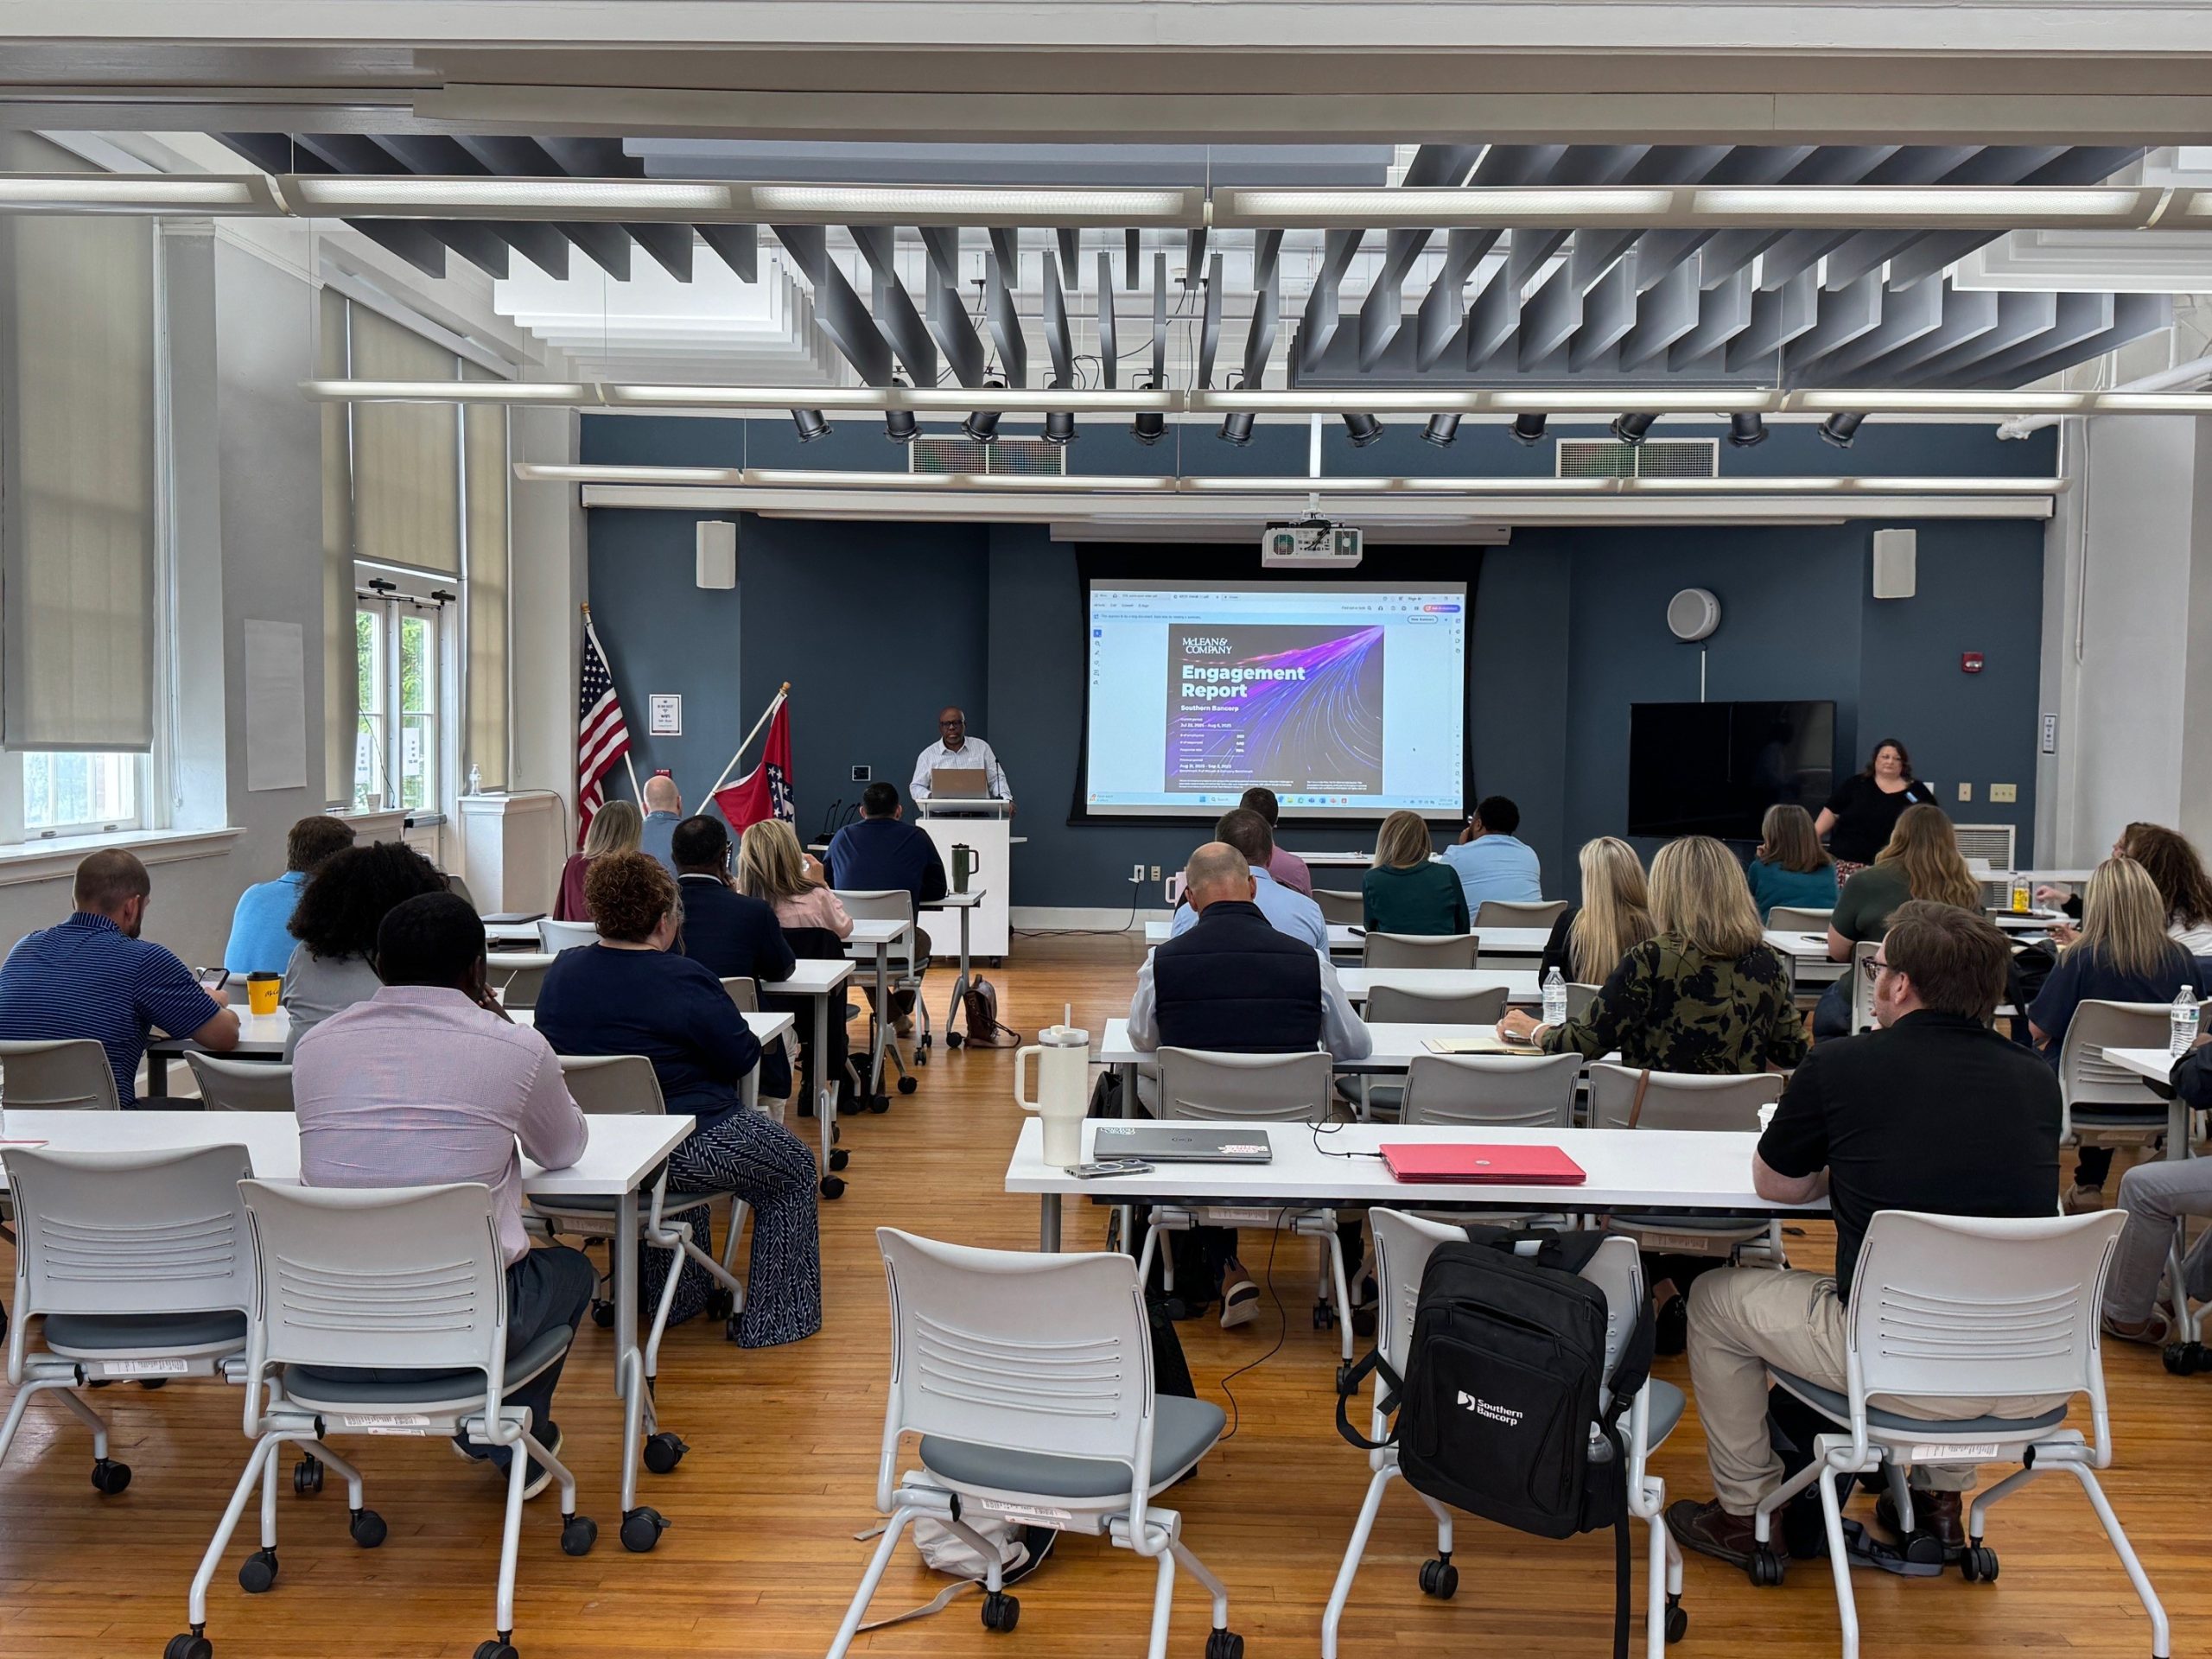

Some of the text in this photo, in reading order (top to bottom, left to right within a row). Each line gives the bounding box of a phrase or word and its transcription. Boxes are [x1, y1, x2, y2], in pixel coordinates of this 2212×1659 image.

[1182, 664, 1306, 683] Engagement
[1181, 683, 1248, 701] Report
[1477, 1405, 1518, 1427] Bancorp
[1478, 1399, 1523, 1419] Southern
